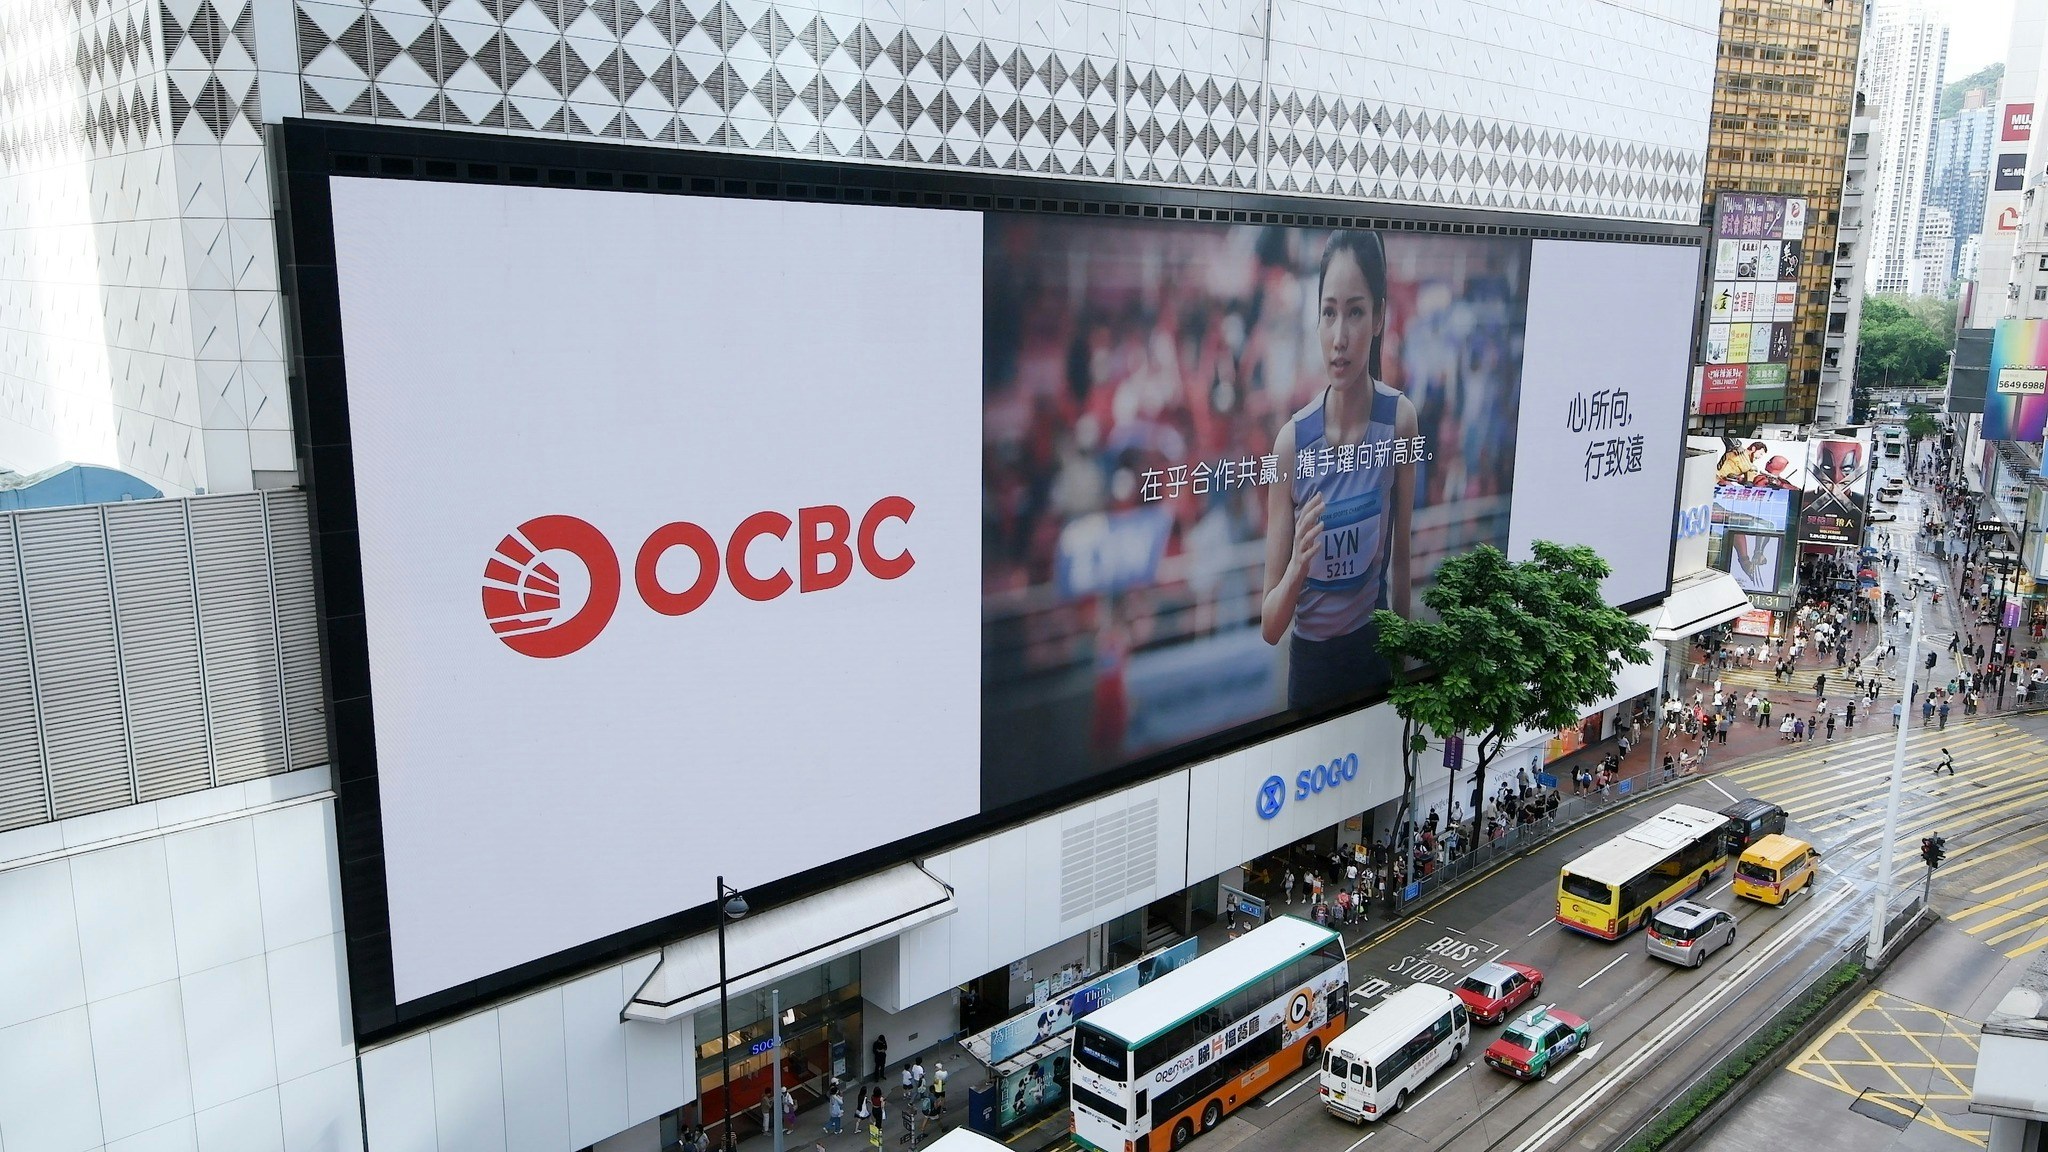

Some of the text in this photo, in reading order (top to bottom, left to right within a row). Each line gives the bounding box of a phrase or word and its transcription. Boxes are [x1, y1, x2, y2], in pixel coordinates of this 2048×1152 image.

[2011, 114, 2032, 125] MU
[1999, 380, 2045, 390] 5649 6988
[1584, 433, 1644, 482] 行致遠
[1679, 504, 1710, 540] OGO
[1977, 524, 2001, 532] LUSH
[634, 496, 915, 616] OCBC
[1325, 527, 1359, 561] LYN
[1326, 559, 1355, 579] 5211
[1295, 752, 1358, 801] SOGO
[1425, 935, 1480, 961] BUS
[1387, 955, 1450, 984] STOP
[1084, 982, 1112, 1003] Think
[1197, 1014, 1260, 1066] 睇片搵餐廳
